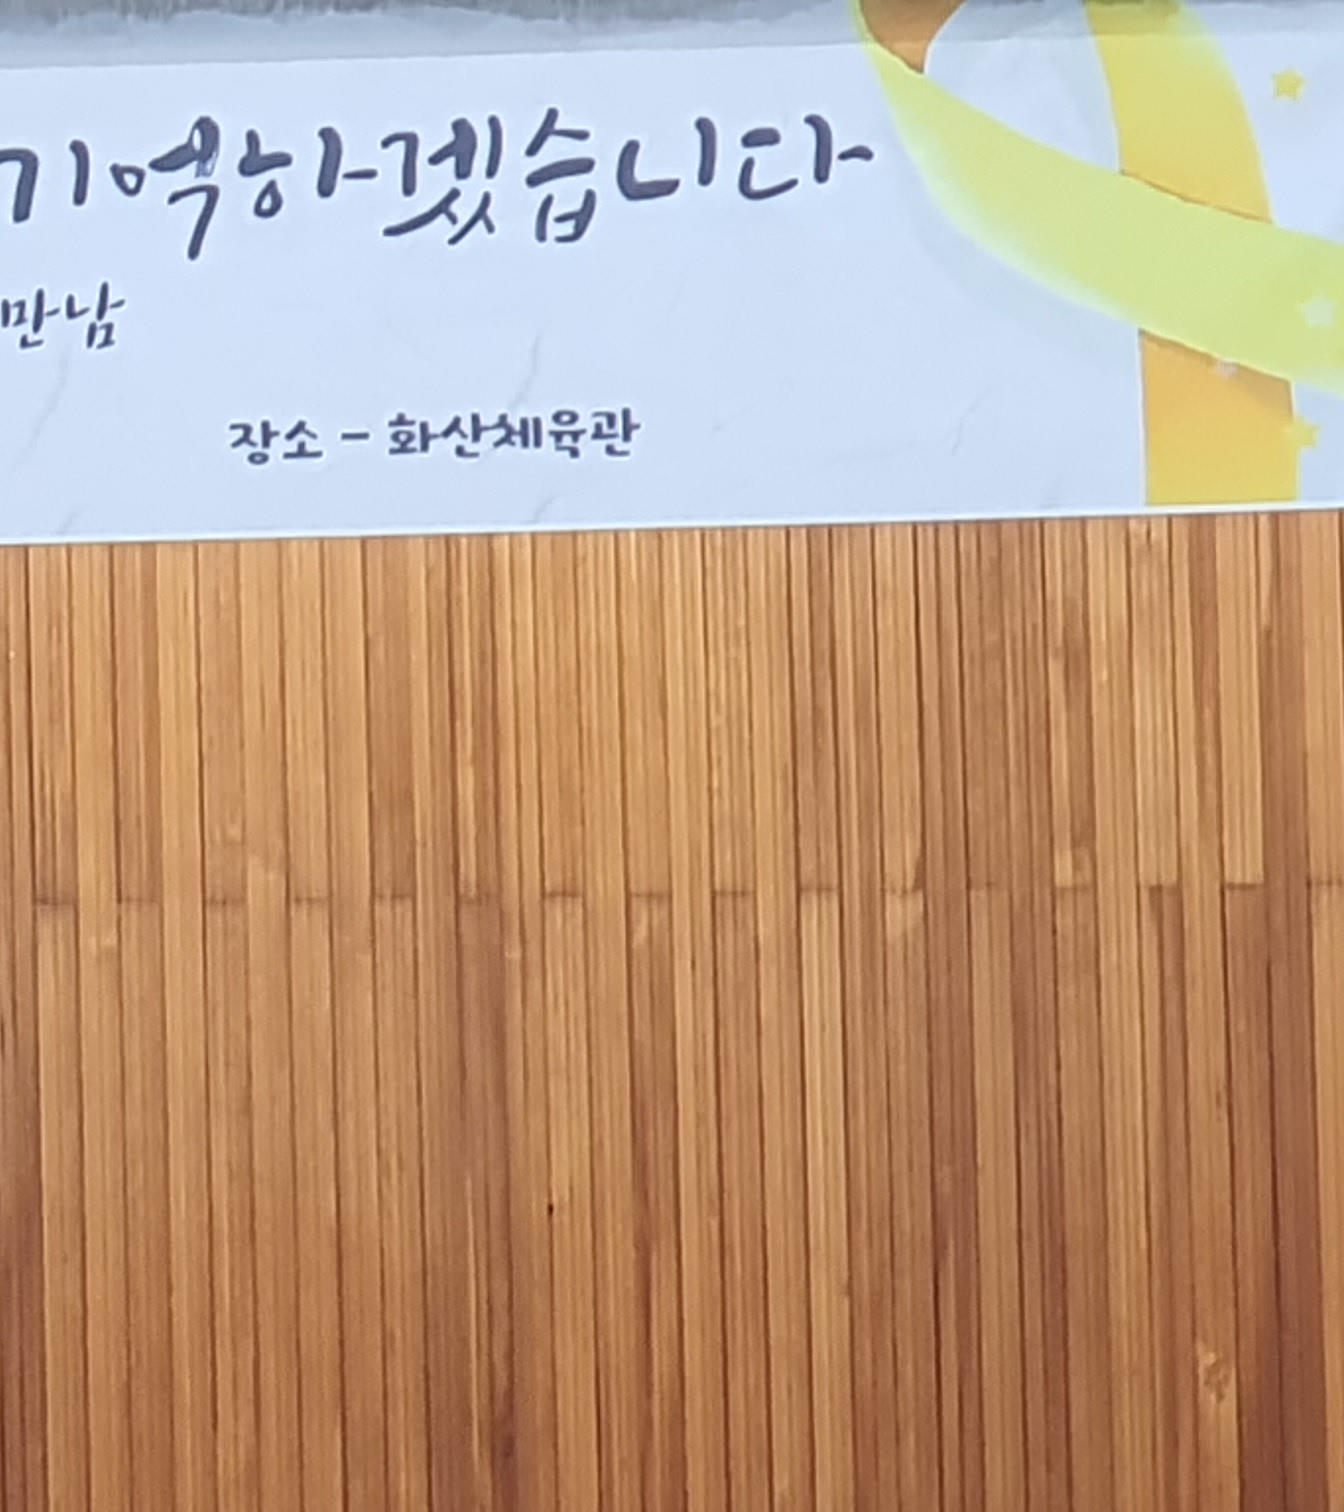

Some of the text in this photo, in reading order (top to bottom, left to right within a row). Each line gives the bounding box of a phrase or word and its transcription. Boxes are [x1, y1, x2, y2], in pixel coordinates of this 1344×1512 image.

[0, 281, 126, 350] 만남
[228, 419, 323, 466] 장소
[387, 407, 642, 460] 화산체육관
